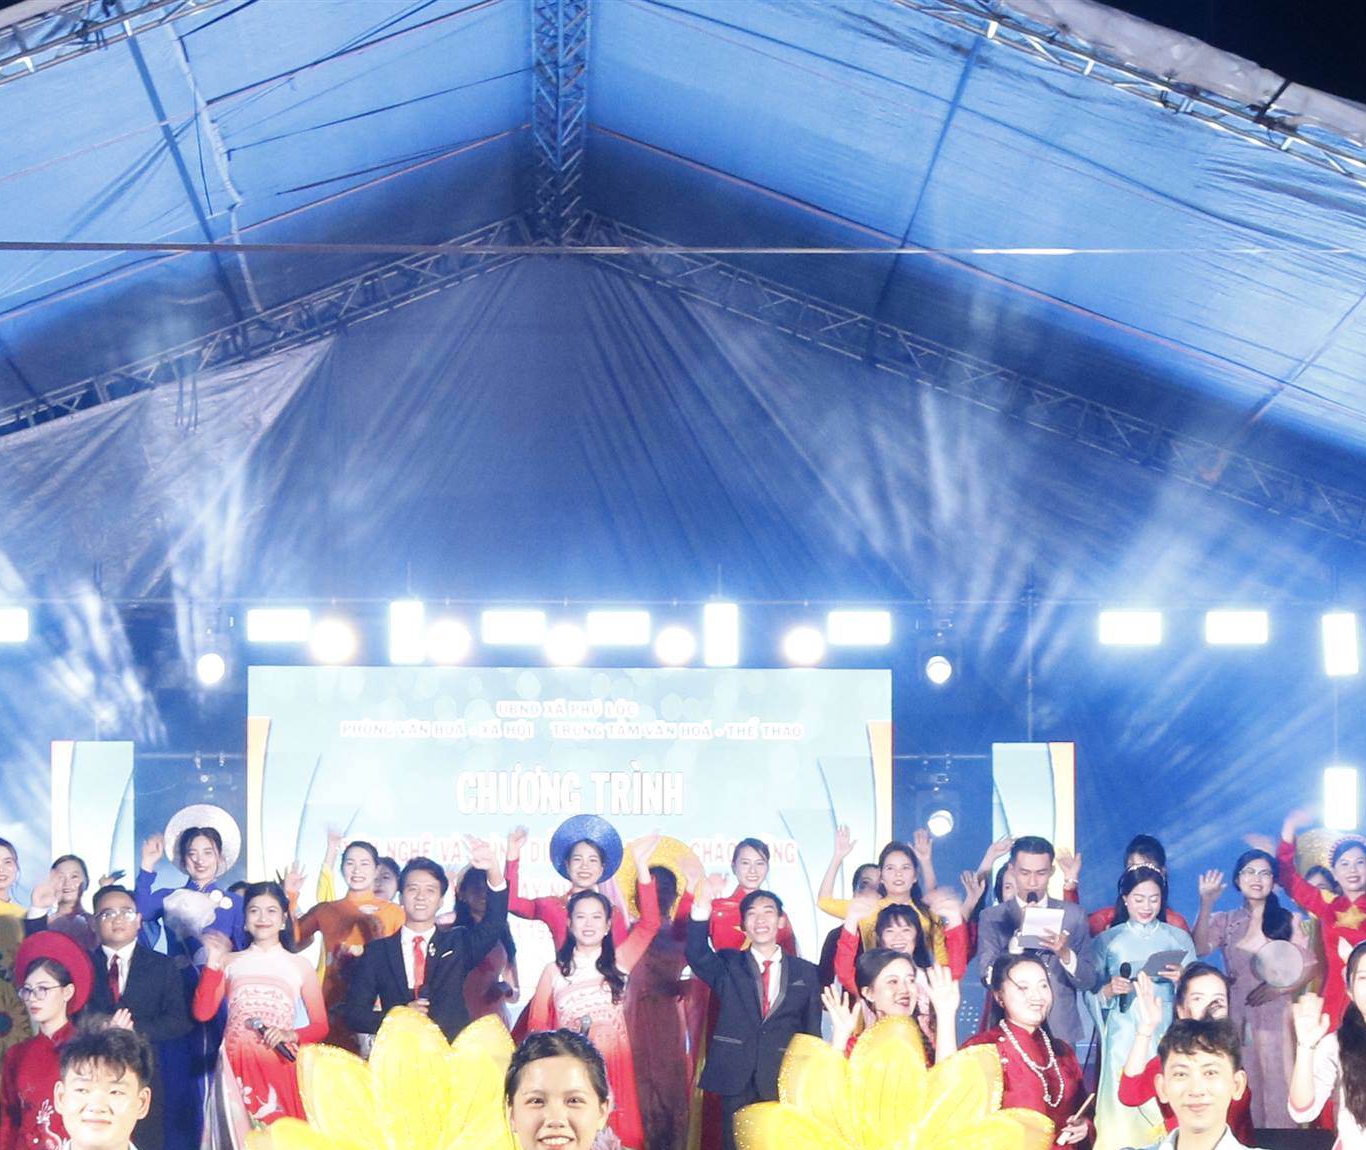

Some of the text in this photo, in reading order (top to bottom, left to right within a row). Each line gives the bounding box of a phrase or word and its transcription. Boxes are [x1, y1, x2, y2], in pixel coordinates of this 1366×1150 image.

[552, 723, 603, 738] TRUNG
[762, 722, 802, 738] THAO
[457, 760, 684, 816] CHƯƠNG TRÌNH
